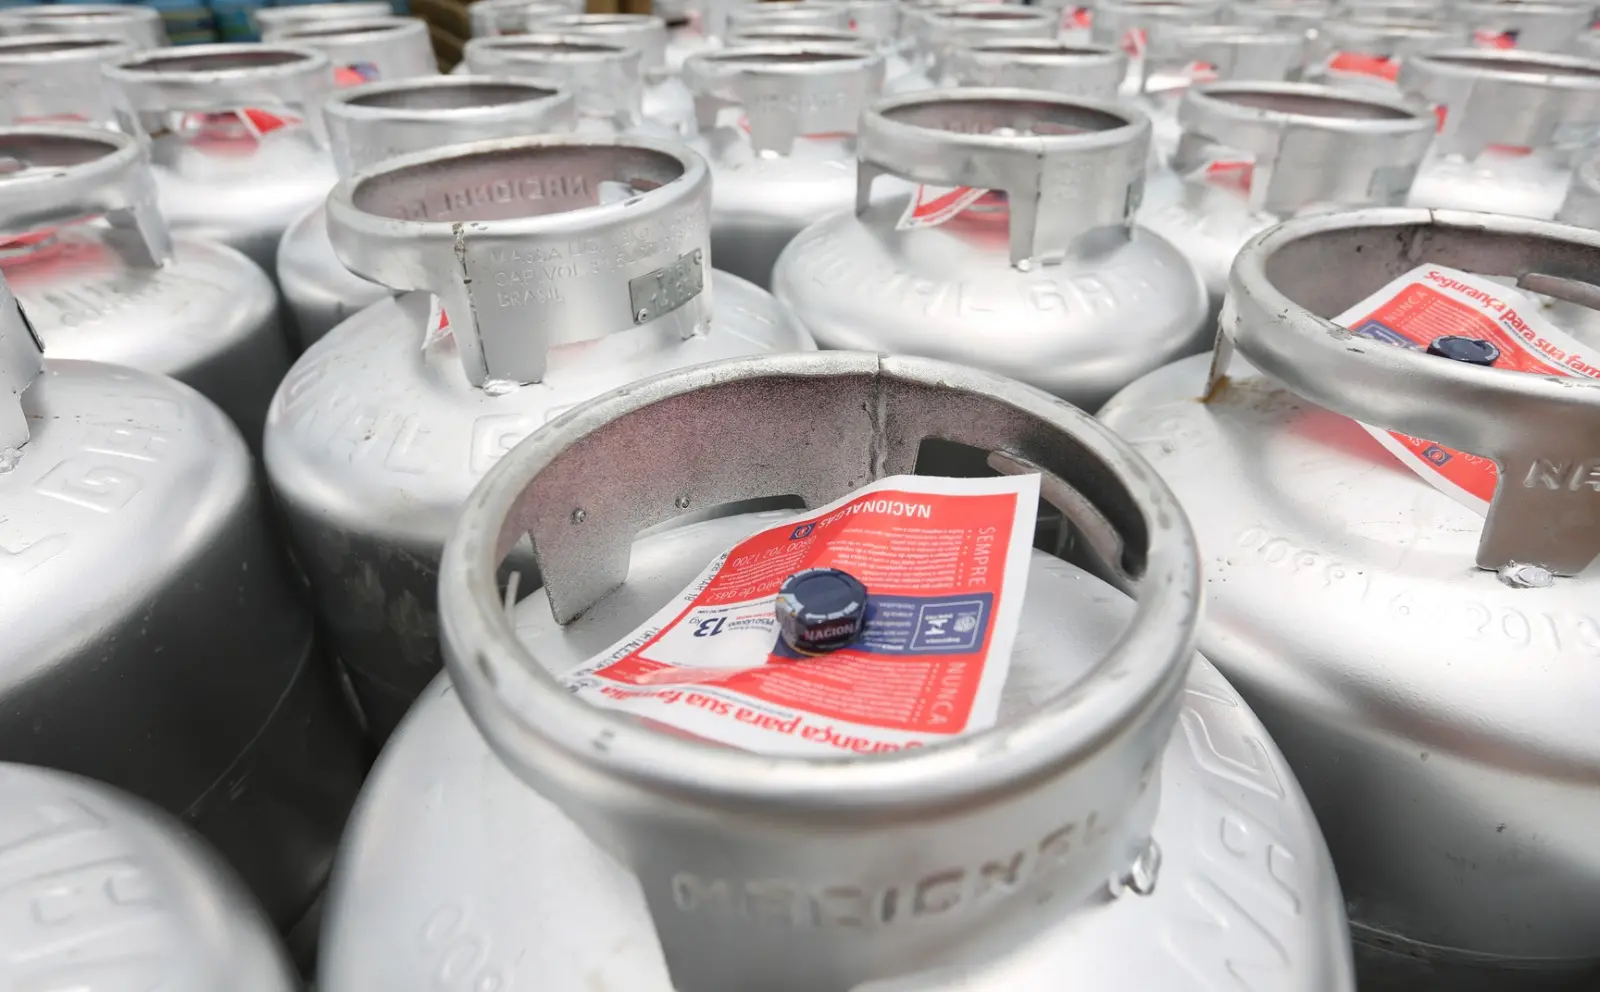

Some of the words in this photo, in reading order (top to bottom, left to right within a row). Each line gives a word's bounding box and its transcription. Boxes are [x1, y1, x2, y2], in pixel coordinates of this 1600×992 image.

[1383, 290, 1428, 322] NUNCA
[1424, 270, 1506, 313] Segurança
[1500, 308, 1537, 343] para
[1534, 336, 1567, 360] sua
[732, 553, 761, 567] 1200
[968, 526, 996, 587] SEMPRE
[740, 586, 756, 598] de
[688, 617, 704, 627] kg
[693, 617, 728, 638] 13
[686, 693, 733, 716] sua
[928, 661, 967, 724] NUNCA
[736, 708, 803, 735] para
